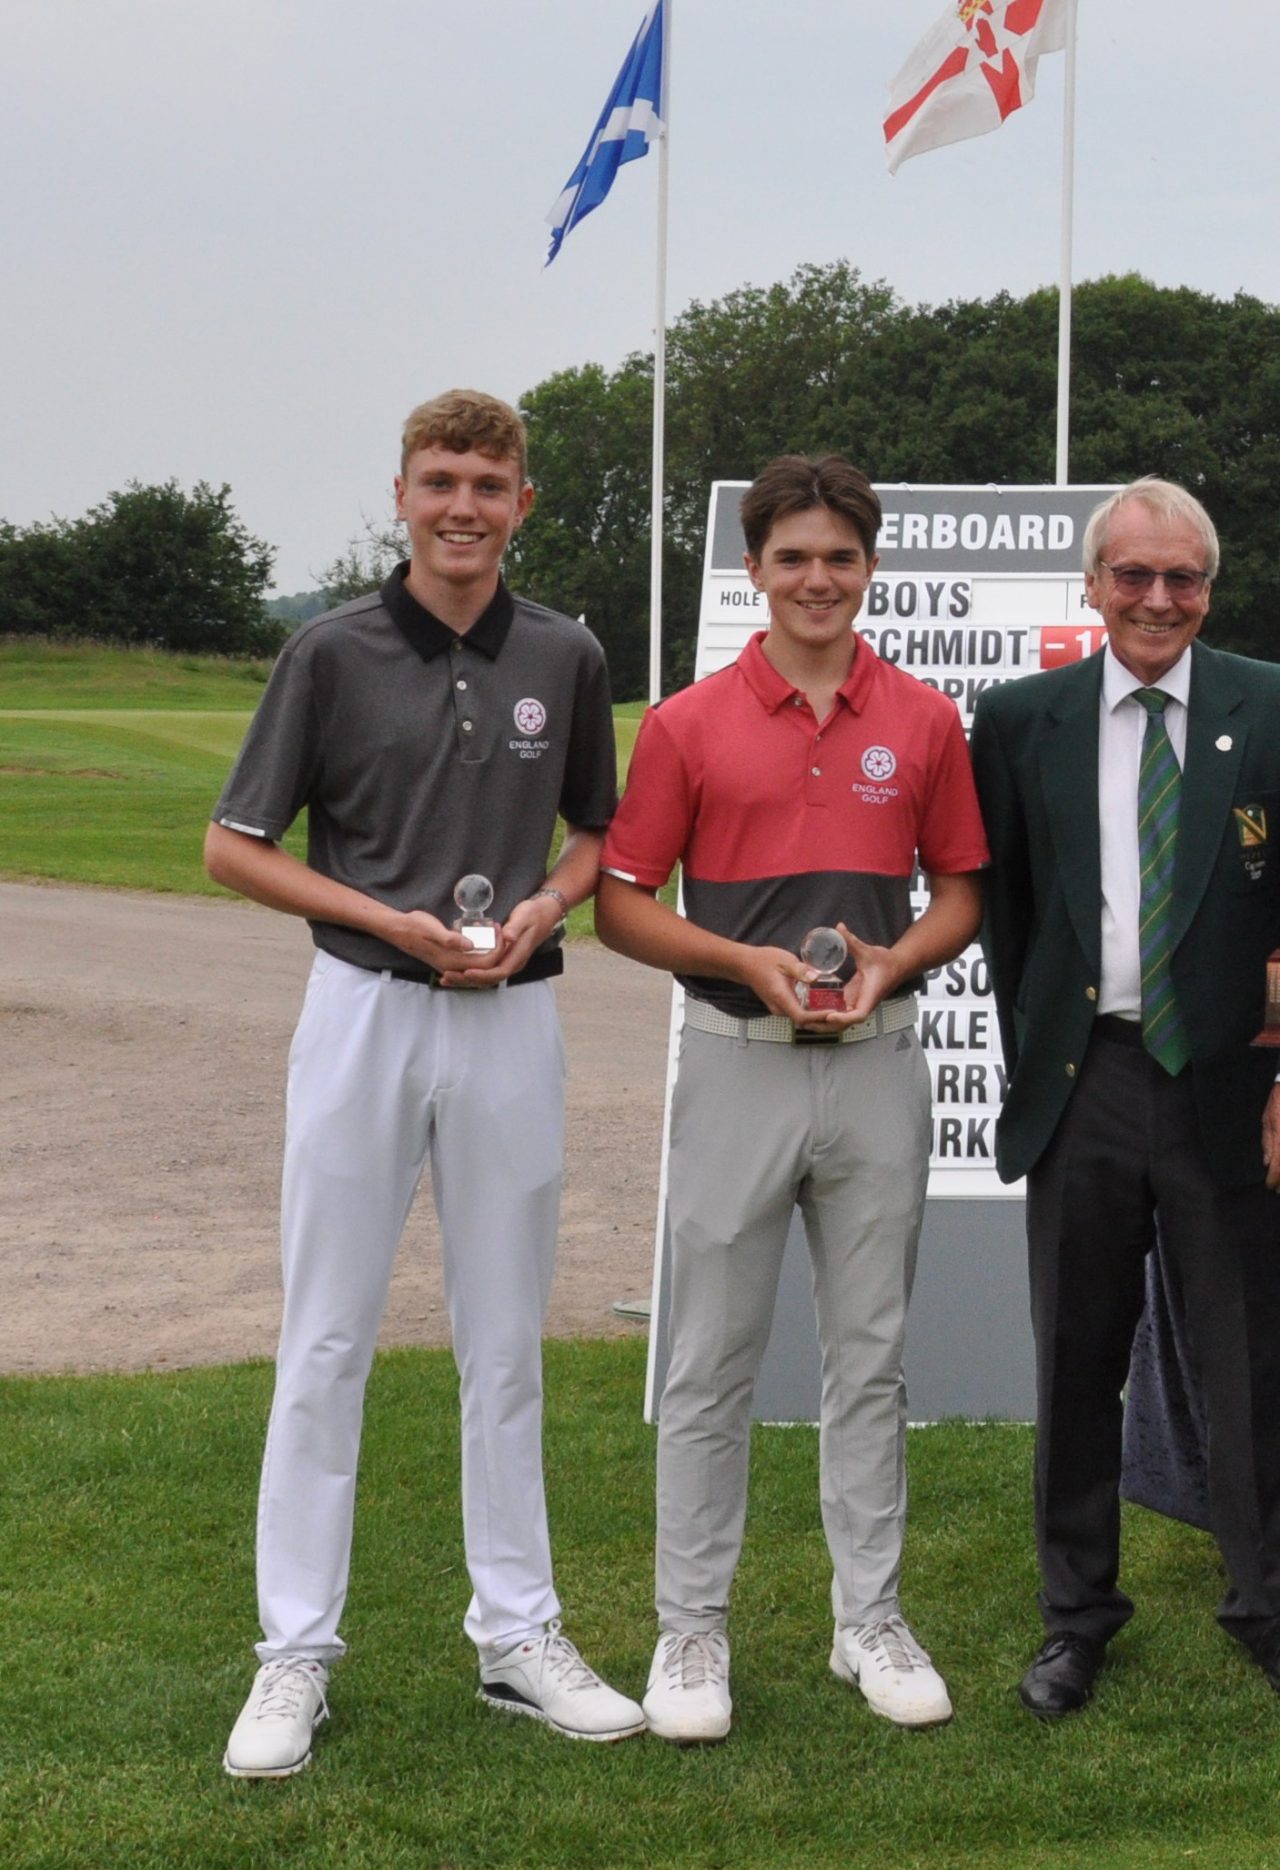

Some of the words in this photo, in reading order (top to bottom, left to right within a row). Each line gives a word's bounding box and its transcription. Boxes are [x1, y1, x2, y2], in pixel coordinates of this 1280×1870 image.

[720, 591, 760, 607] HOLE
[867, 581, 971, 618] BOYS
[509, 740, 549, 750] ENGLAND
[519, 750, 541, 759] GOLF
[852, 783, 899, 797] ENGLAND
[862, 793, 889, 805] GOLF
[921, 1011, 988, 1050] KLE
